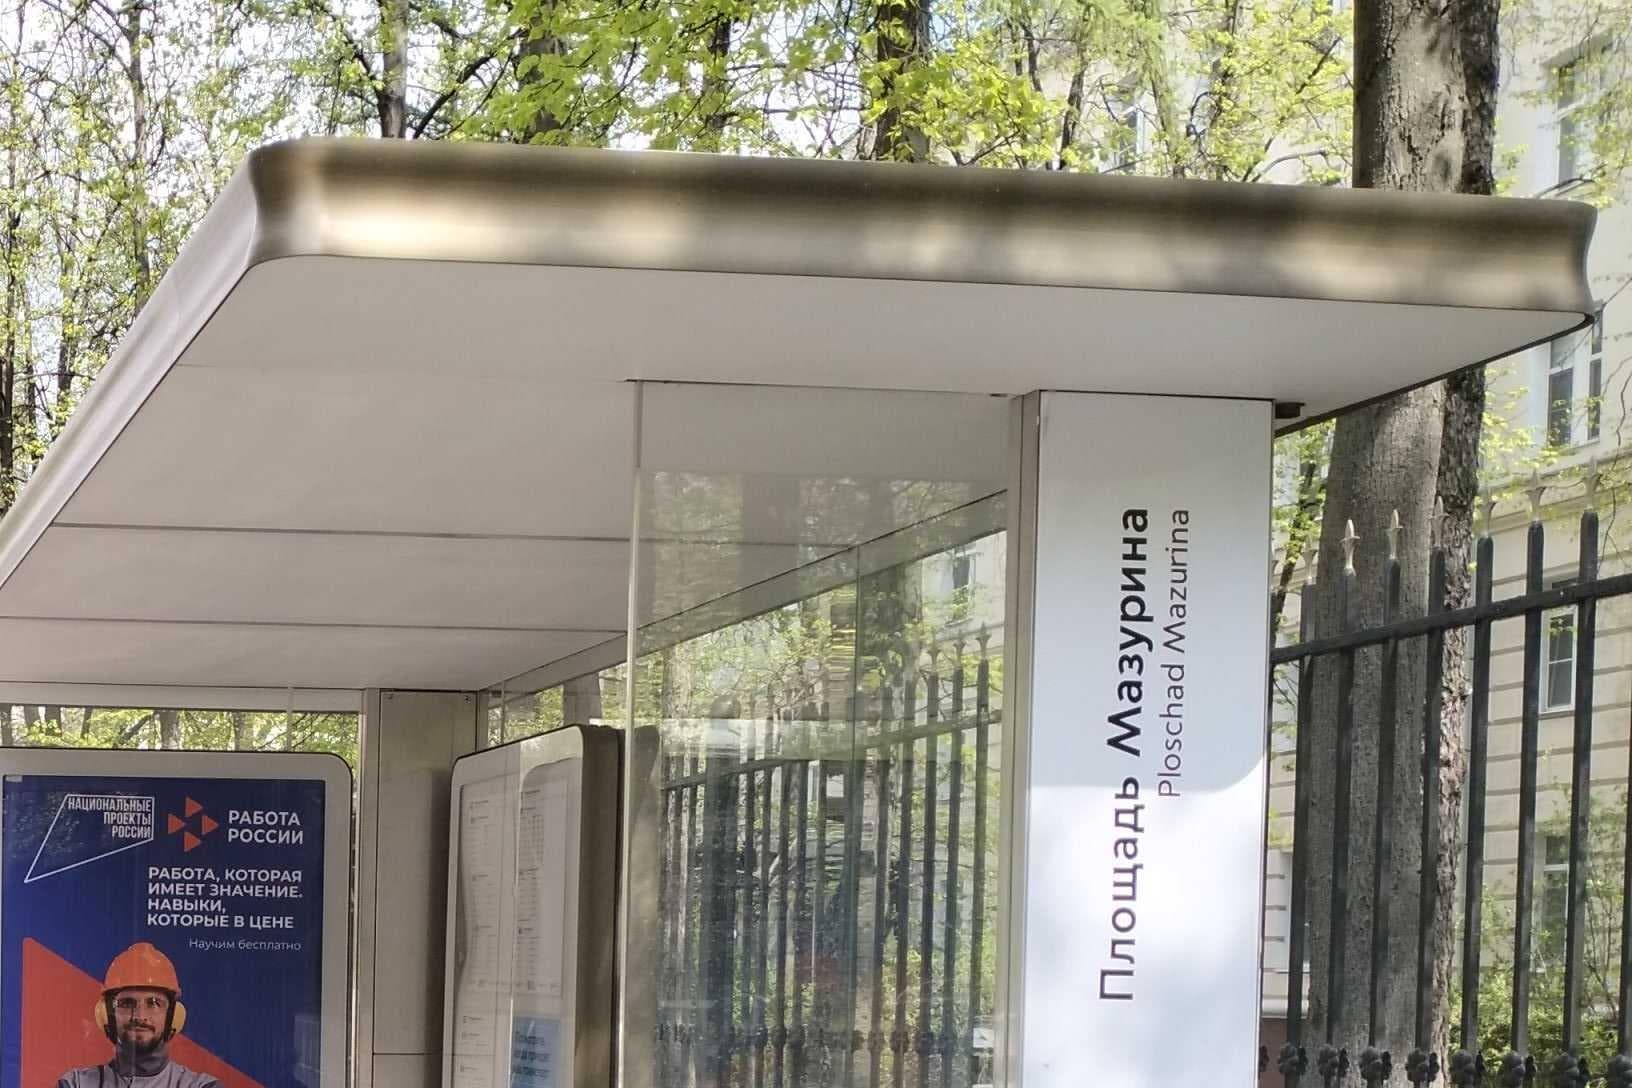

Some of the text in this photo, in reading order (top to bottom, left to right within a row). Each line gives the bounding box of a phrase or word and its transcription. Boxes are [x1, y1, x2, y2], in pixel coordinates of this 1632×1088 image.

[1158, 509, 1190, 797] Ploschad Mazurina
[1099, 508, 1154, 1001] Площадь Мазурина
[67, 797, 152, 812] НАЦИОНАЛЬНЫЕ
[103, 812, 152, 825] ПРОЕКТЫ
[227, 809, 301, 826] РАБОТА
[111, 825, 152, 839] РОССИИ
[227, 828, 304, 845] РОССИИ
[148, 866, 302, 882] РАБОТА, КОТОРАЯ
[148, 883, 303, 898] ИМЕЕТ ЗНАЧЕНИЕ.
[147, 899, 226, 914] НАВЫКИ,
[147, 914, 294, 930] КОТОРЫЕ В ЦЕНЕ
[189, 938, 302, 952] Научим бесплатно
